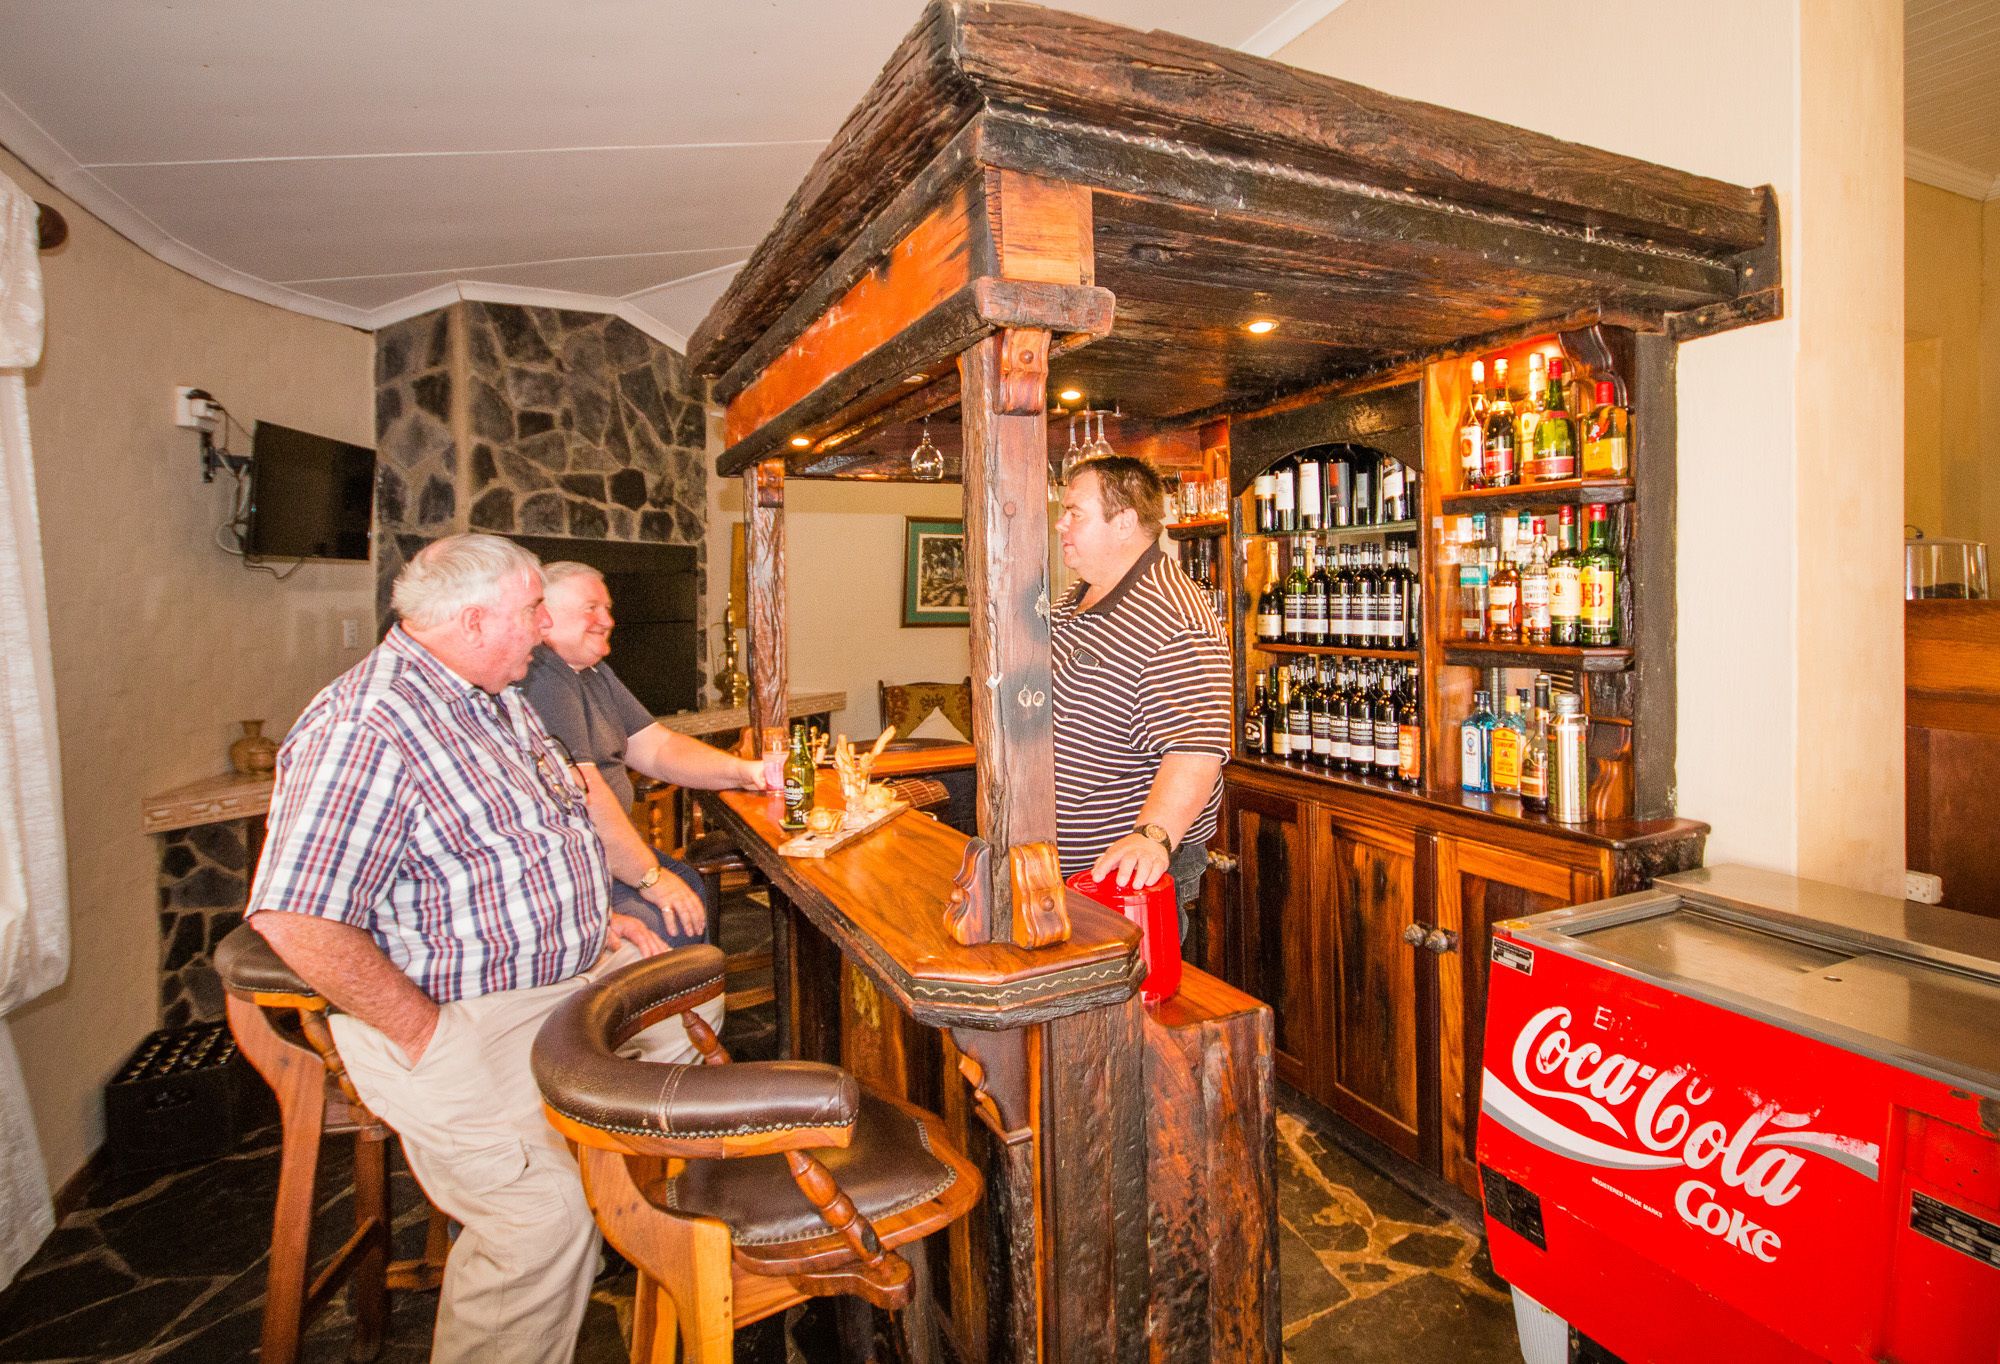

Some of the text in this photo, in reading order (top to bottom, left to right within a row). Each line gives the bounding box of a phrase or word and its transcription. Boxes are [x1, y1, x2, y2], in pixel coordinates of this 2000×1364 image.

[1548, 571, 1579, 581] AMESON
[1512, 1006, 1823, 1207] Coca-Cola
[1591, 1176, 1624, 1198] REGISTERED
[1624, 1193, 1643, 1208] TRADE
[1674, 1179, 1782, 1263] Coke
